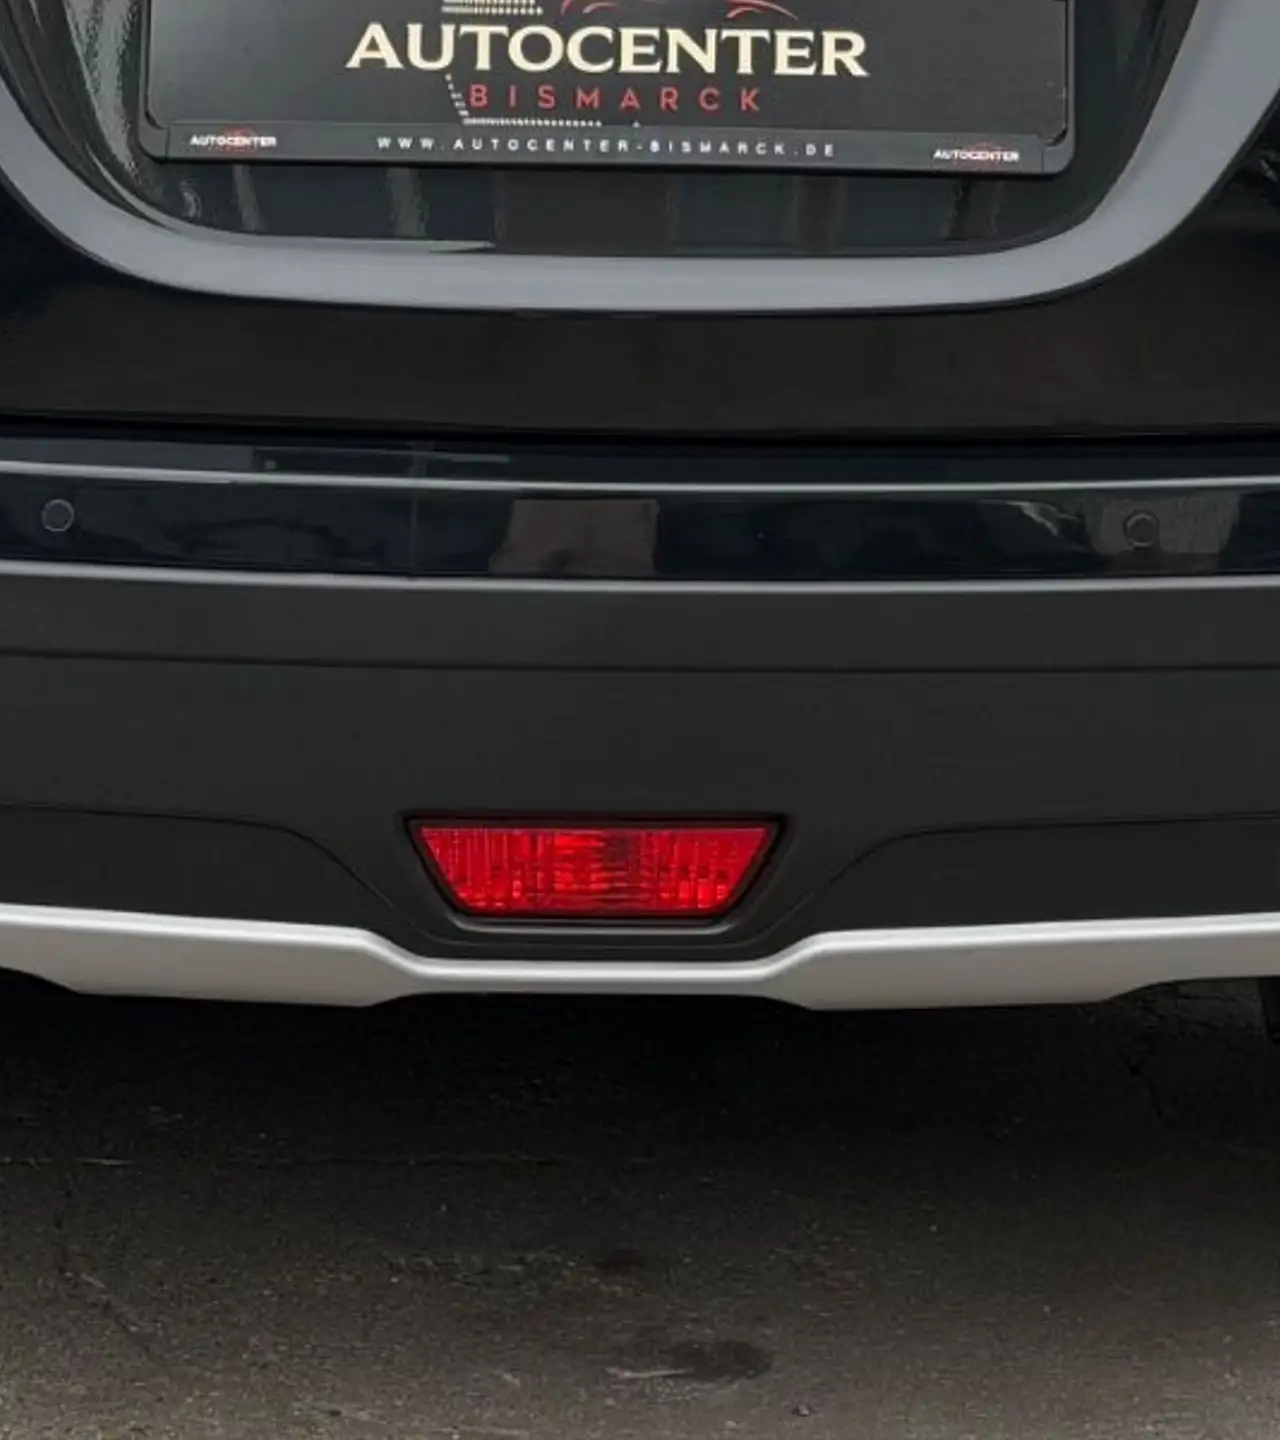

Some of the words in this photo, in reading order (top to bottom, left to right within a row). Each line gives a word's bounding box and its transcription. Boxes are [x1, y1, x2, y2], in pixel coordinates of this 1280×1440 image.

[345, 22, 870, 77] AUTOCENTER
[468, 83, 760, 112] BISMARCK
[376, 136, 836, 158] WWW.AUTOCENTER-BISMARCK.DE
